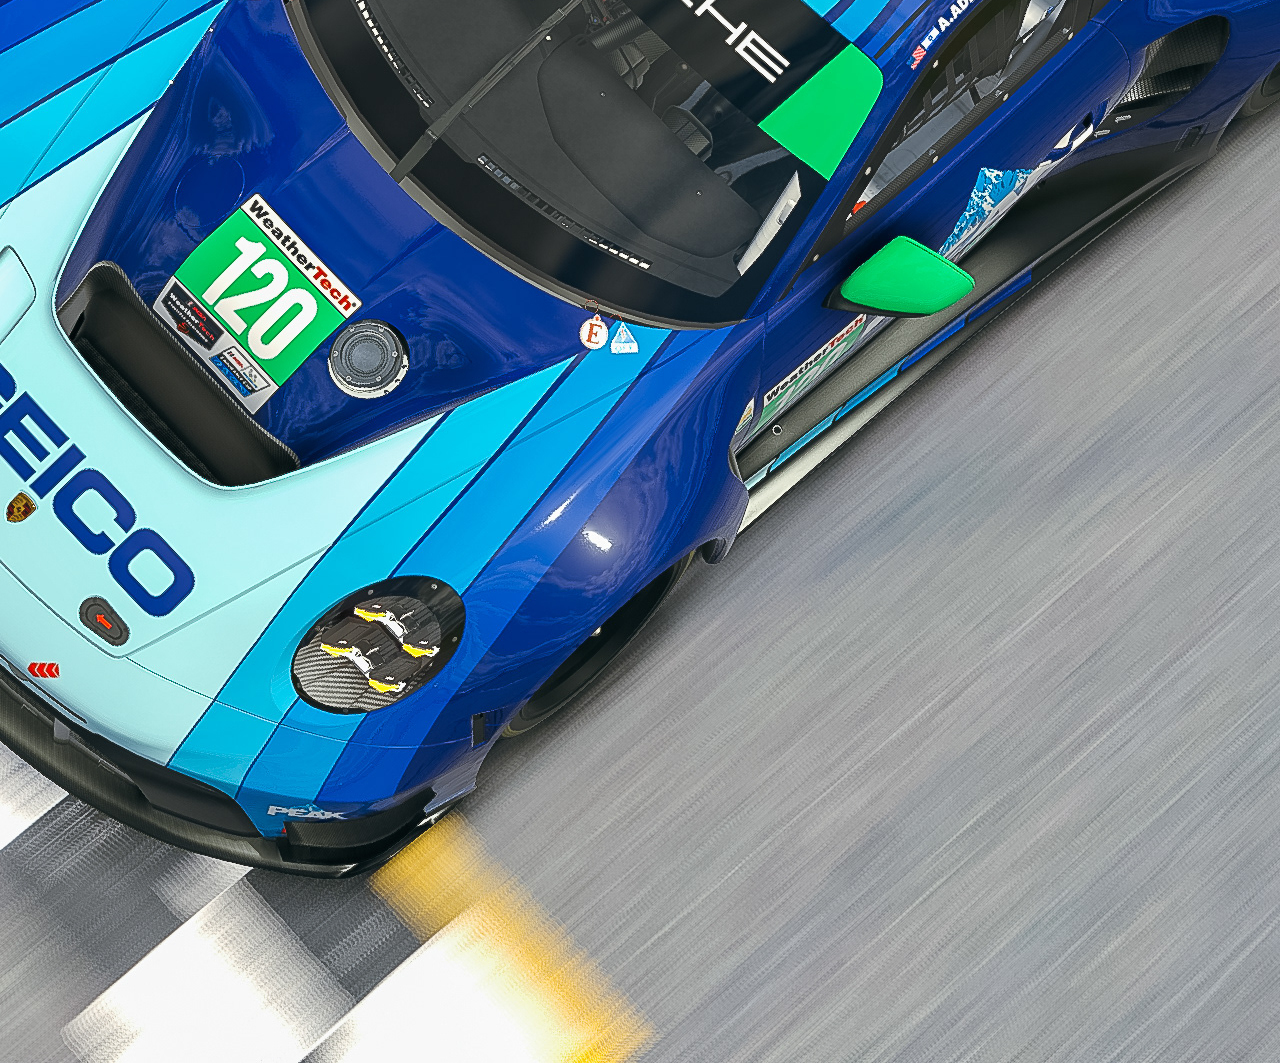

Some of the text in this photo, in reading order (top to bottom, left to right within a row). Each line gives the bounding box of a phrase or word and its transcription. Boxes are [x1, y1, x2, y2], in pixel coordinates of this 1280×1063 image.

[201, 235, 318, 360] 120
[248, 199, 353, 312] WeatherTech
[586, 322, 602, 344] E
[766, 317, 864, 401] WeatherTech
[267, 805, 348, 820] PEAK
